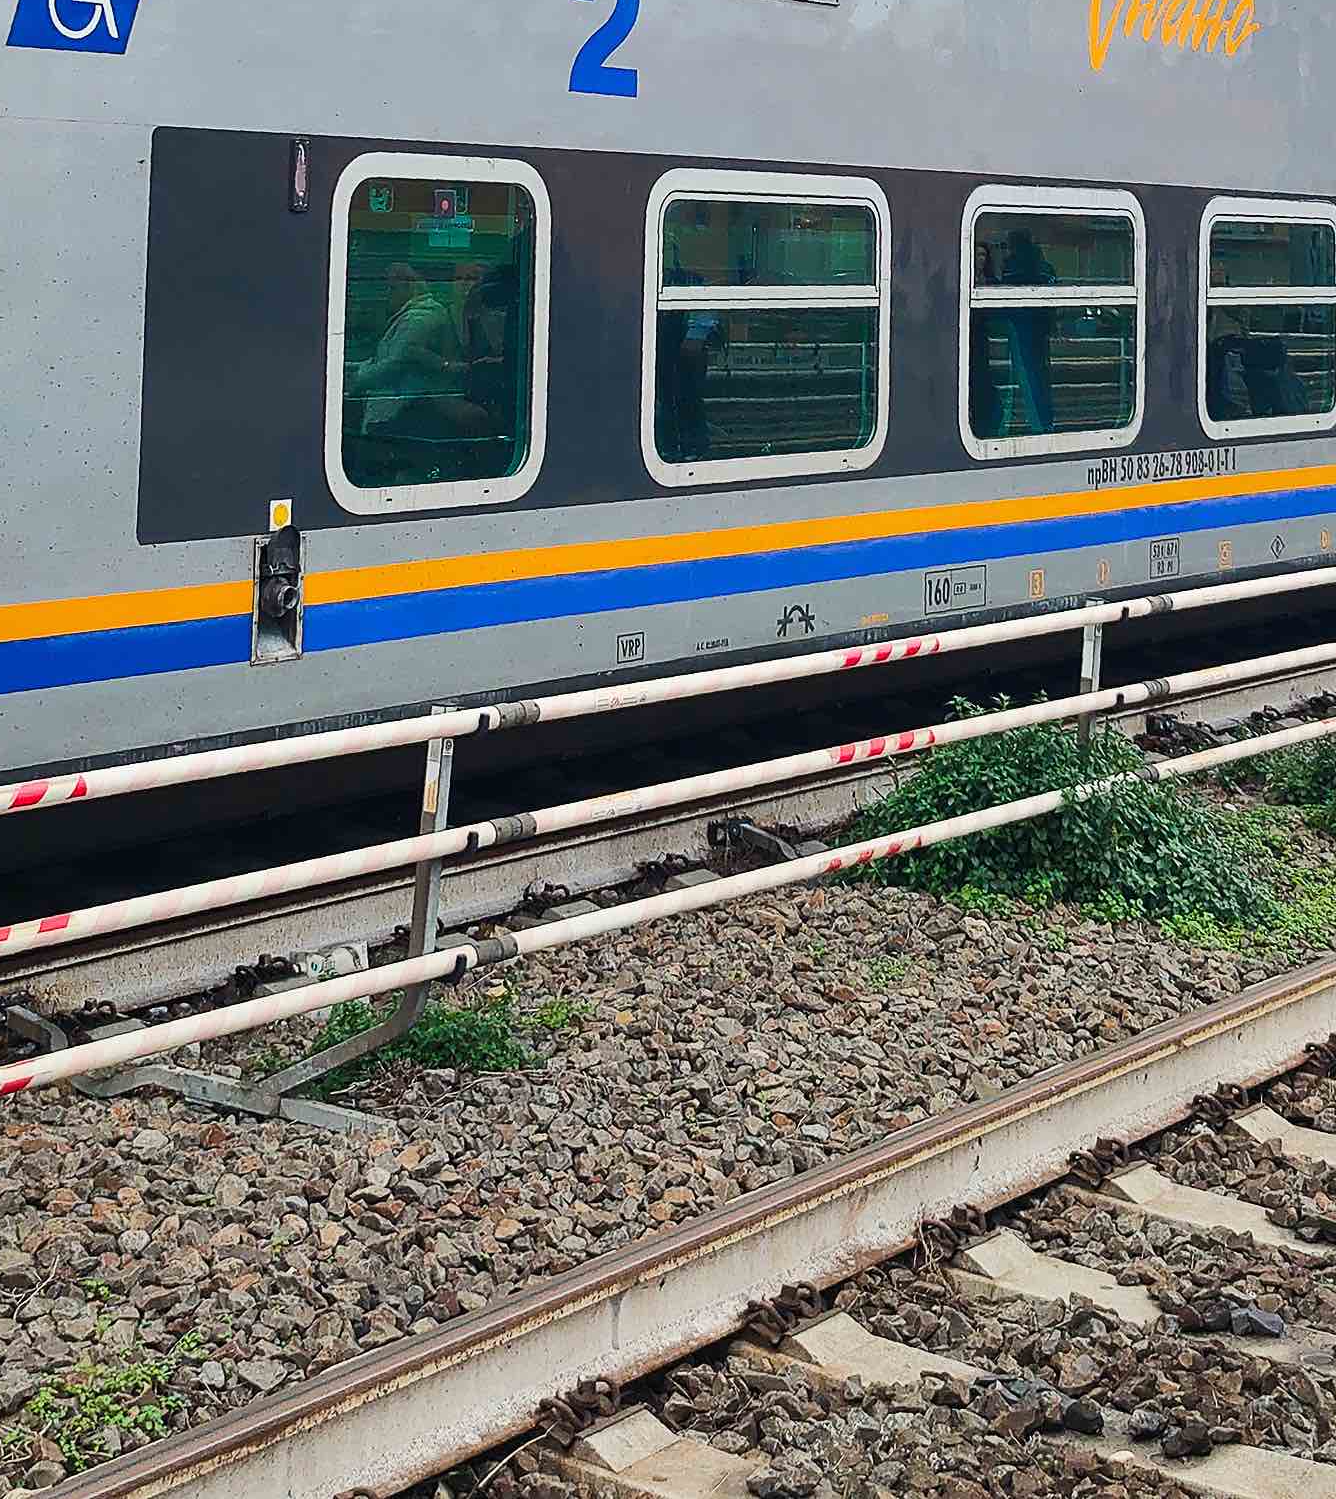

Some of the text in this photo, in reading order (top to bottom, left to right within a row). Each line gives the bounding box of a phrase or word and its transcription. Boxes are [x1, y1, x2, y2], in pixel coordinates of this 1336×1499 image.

[1087, 458, 1117, 490] npBH
[1120, 457, 1133, 481] 50
[1137, 455, 1150, 479] 83
[1152, 452, 1182, 478] 26-78
[927, 577, 950, 606] 160
[620, 638, 640, 657] VRP
